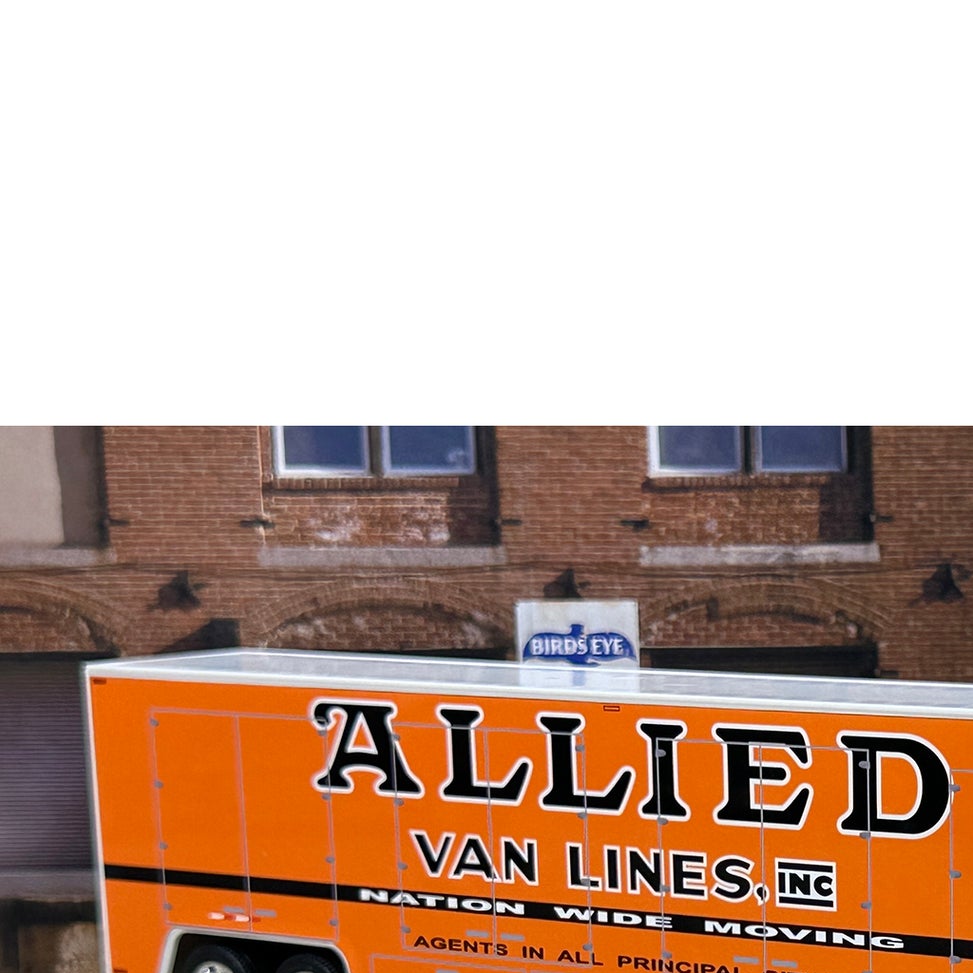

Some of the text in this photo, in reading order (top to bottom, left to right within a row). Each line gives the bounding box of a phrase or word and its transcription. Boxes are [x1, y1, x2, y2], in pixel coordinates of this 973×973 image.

[309, 697, 954, 839] ALLIED
[409, 829, 836, 907] VAN LINES, INC
[360, 888, 905, 949] NATION WIDE MOVING
[413, 935, 508, 956] AGENTS
[522, 945, 545, 960] IN
[557, 949, 604, 966] ALL
